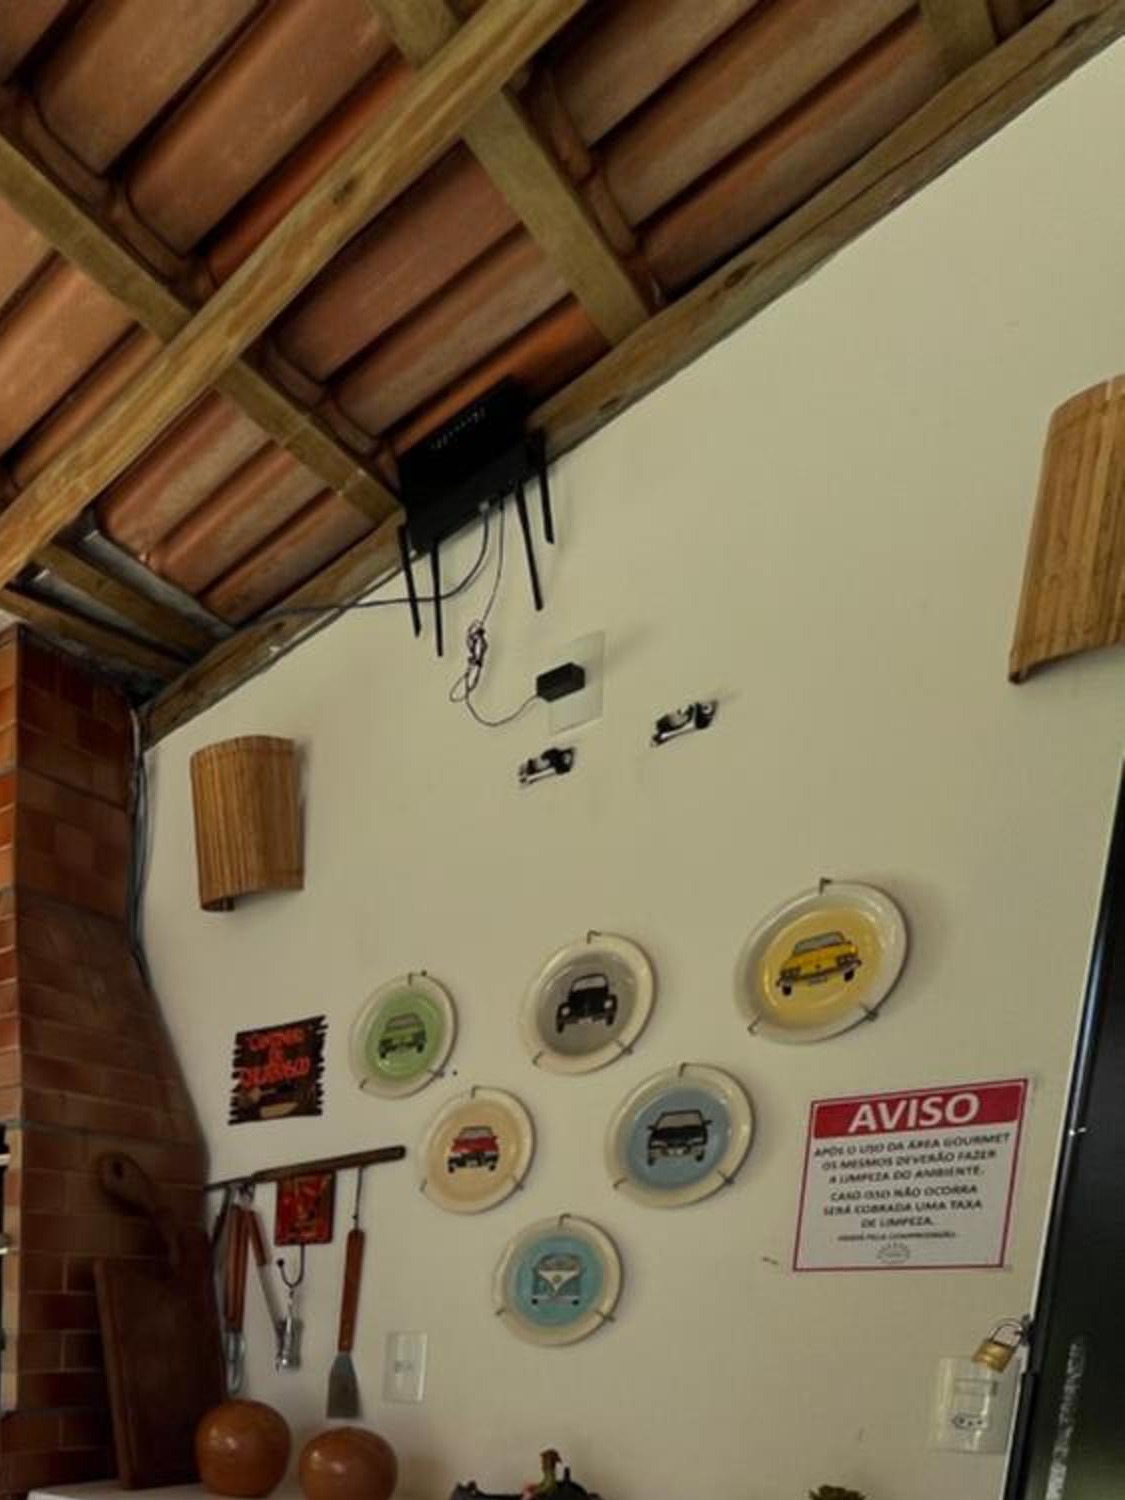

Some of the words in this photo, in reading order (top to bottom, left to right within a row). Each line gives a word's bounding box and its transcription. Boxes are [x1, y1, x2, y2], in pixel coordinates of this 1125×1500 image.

[847, 1092, 981, 1133] AVISO
[814, 1144, 844, 1156] APÓS
[858, 1142, 884, 1153] USO
[887, 1141, 904, 1151] DA
[906, 1137, 940, 1149] ÁREA
[943, 1132, 1010, 1147] GOURMET
[821, 1160, 837, 1170] OS
[839, 1156, 892, 1169] MESMOS
[896, 1150, 954, 1165] DEVERÃO
[957, 1149, 996, 1160] FAZER
[839, 1171, 890, 1183] LIMPEZA
[893, 1170, 910, 1180] DO
[830, 1190, 861, 1200] CASO
[863, 1189, 890, 1199] ISSO
[893, 1186, 921, 1197] NÃO
[924, 1184, 978, 1195] OCORRA
[824, 1204, 850, 1215] SERÁ
[854, 1202, 911, 1214] COBRADA
[915, 1200, 946, 1211] UMA
[950, 1199, 982, 1209] TAXA
[860, 1218, 876, 1228] DE
